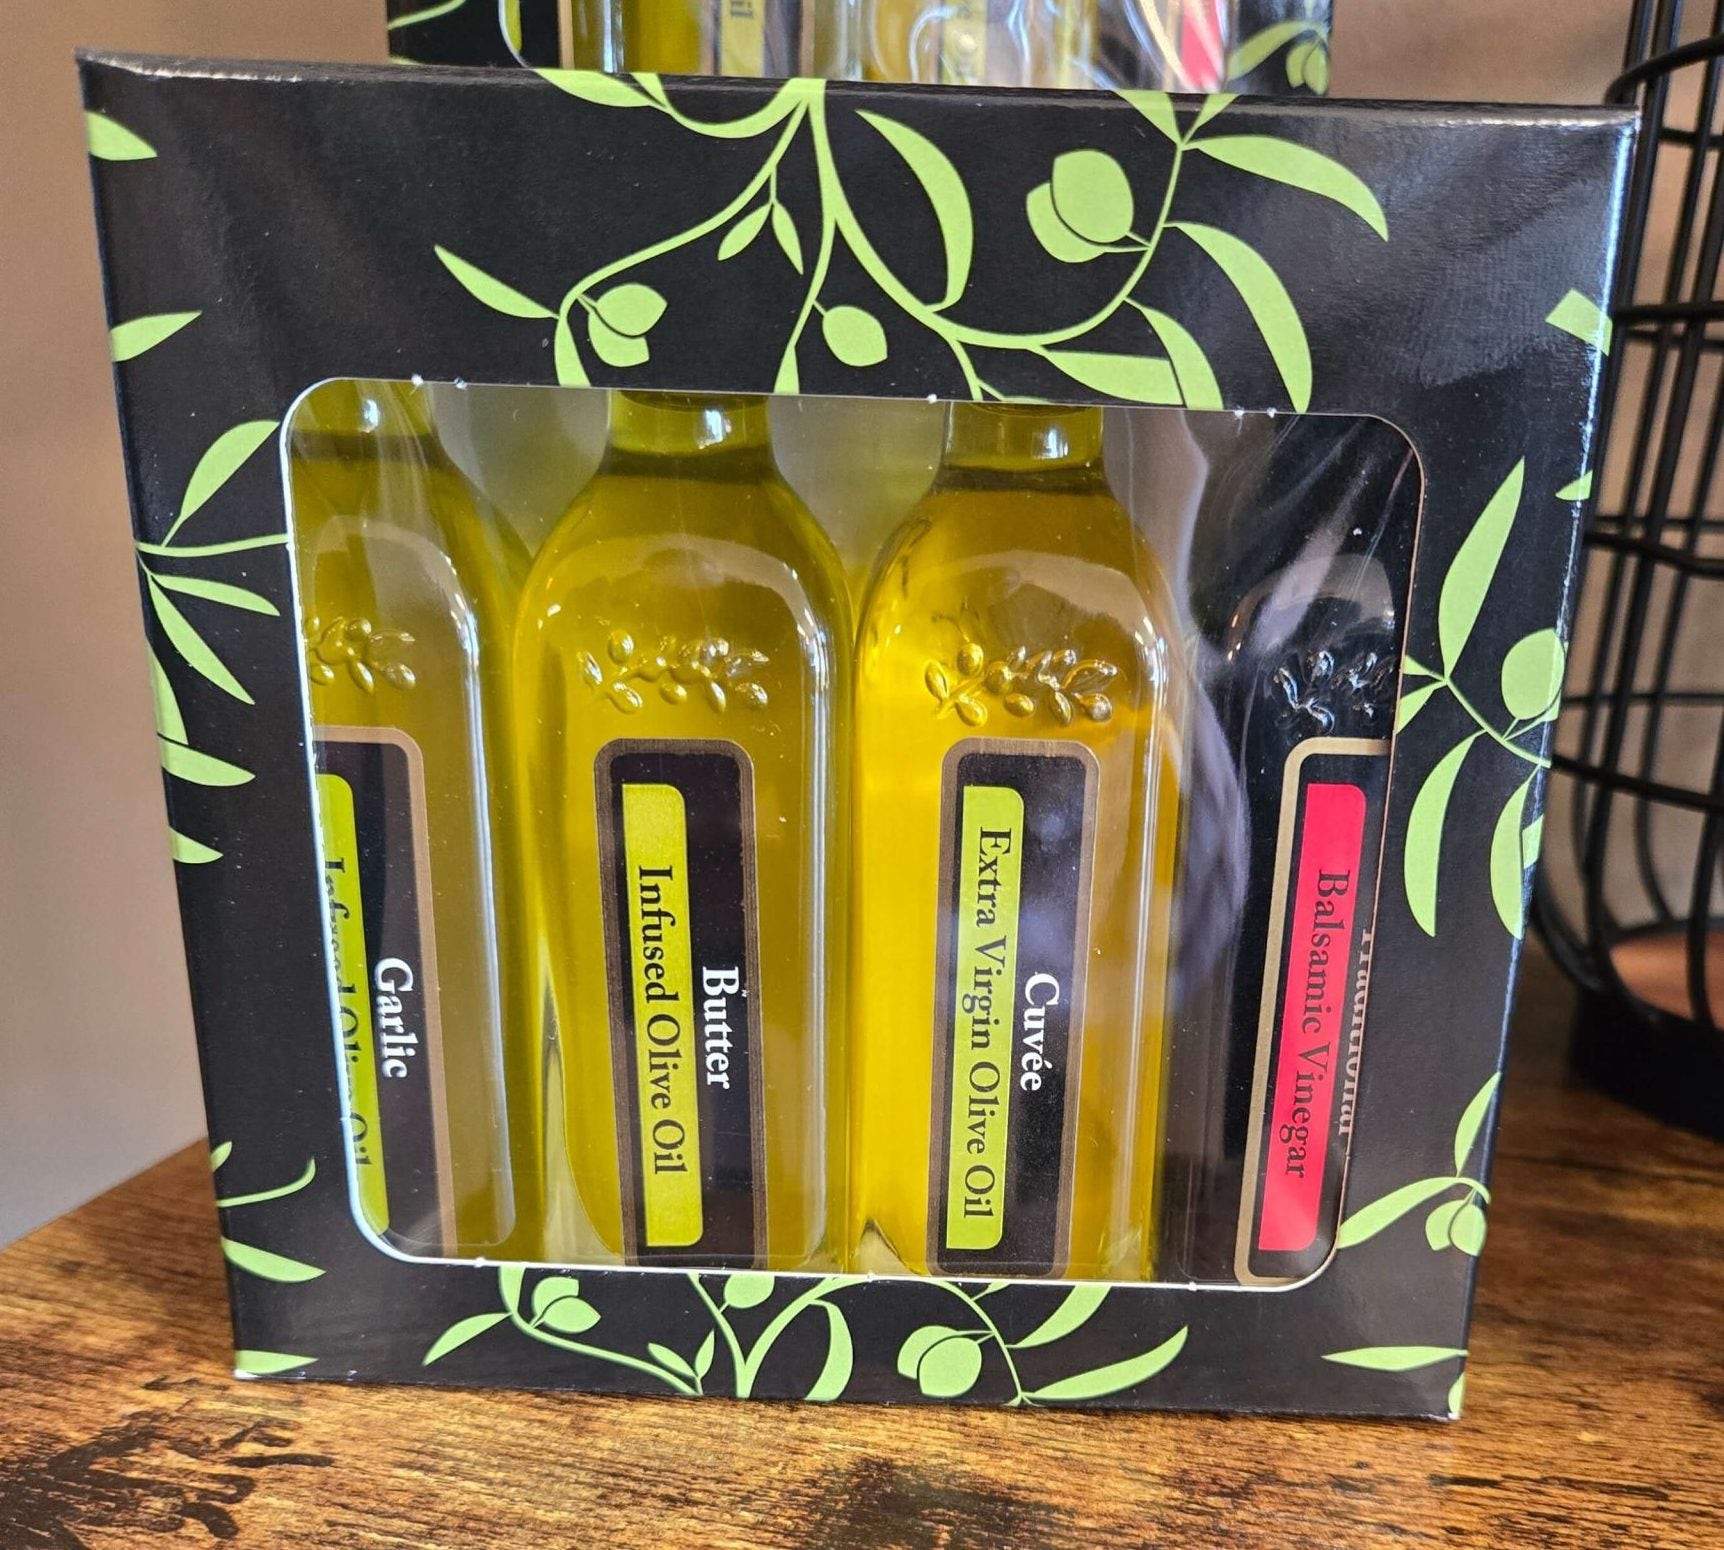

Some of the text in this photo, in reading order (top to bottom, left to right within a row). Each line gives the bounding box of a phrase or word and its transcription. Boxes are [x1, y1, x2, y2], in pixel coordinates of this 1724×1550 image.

[374, 957, 415, 1080] Garlic
[638, 865, 688, 1175] Infused Olive Oil
[701, 966, 739, 1091] Butter
[960, 826, 1012, 1219] Extra Virgin Olive Oil
[1020, 974, 1060, 1091] Cuvée
[1280, 869, 1351, 1178] Balsamic Vinegar
